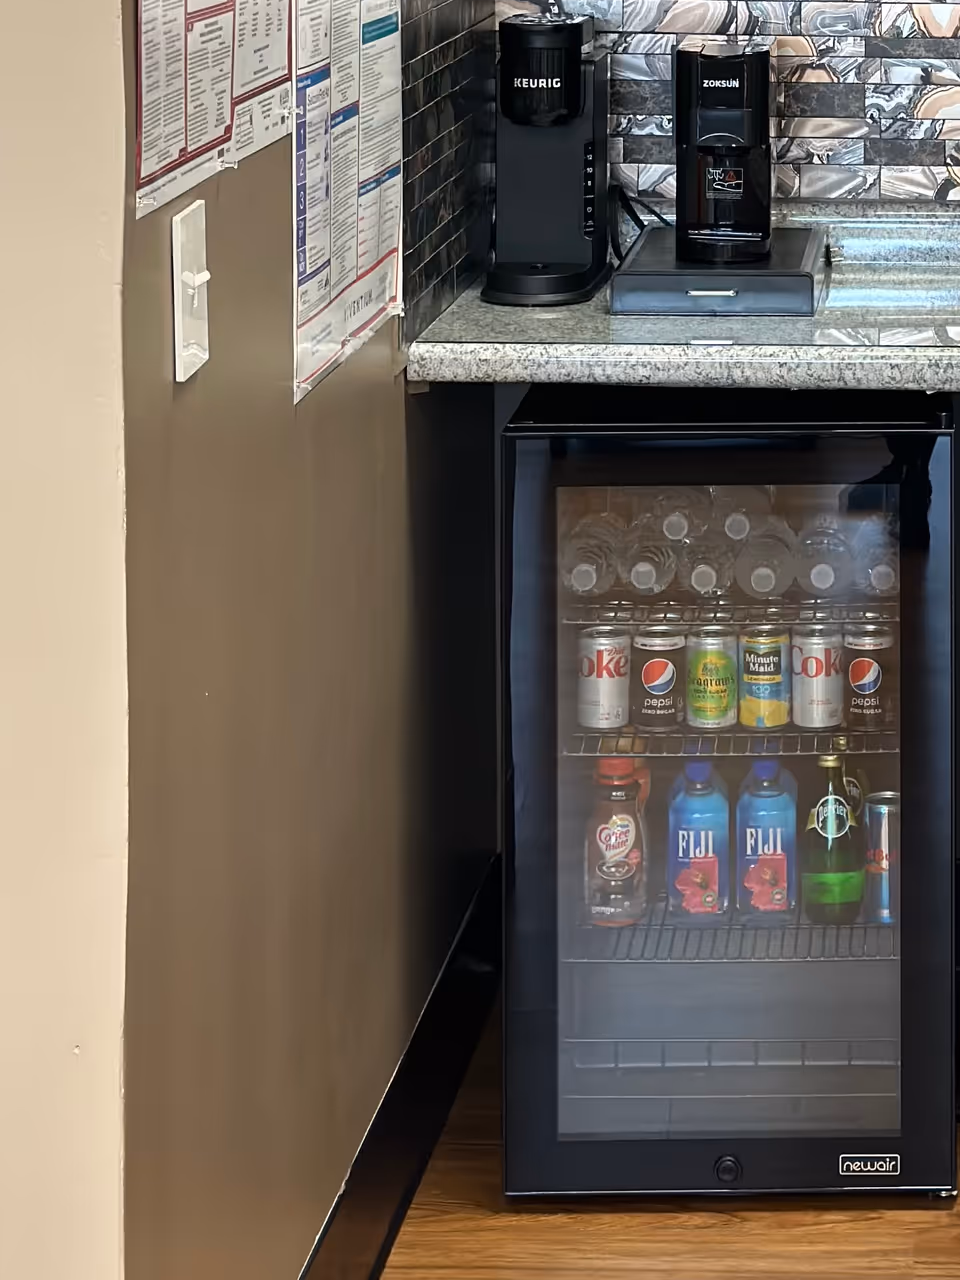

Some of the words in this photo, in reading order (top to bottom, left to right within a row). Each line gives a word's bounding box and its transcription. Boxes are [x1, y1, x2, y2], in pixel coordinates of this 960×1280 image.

[514, 78, 561, 89] KEURIG
[702, 78, 739, 88] ZOKSUN
[580, 649, 628, 679] oke
[745, 652, 779, 664] Minute
[792, 645, 842, 678] Cok
[750, 663, 774, 672] Maid
[644, 696, 673, 708] pepsi
[851, 696, 880, 707] pepsi
[678, 830, 714, 858] FIJI
[746, 828, 783, 855] FIJI
[843, 1157, 896, 1171] newair
